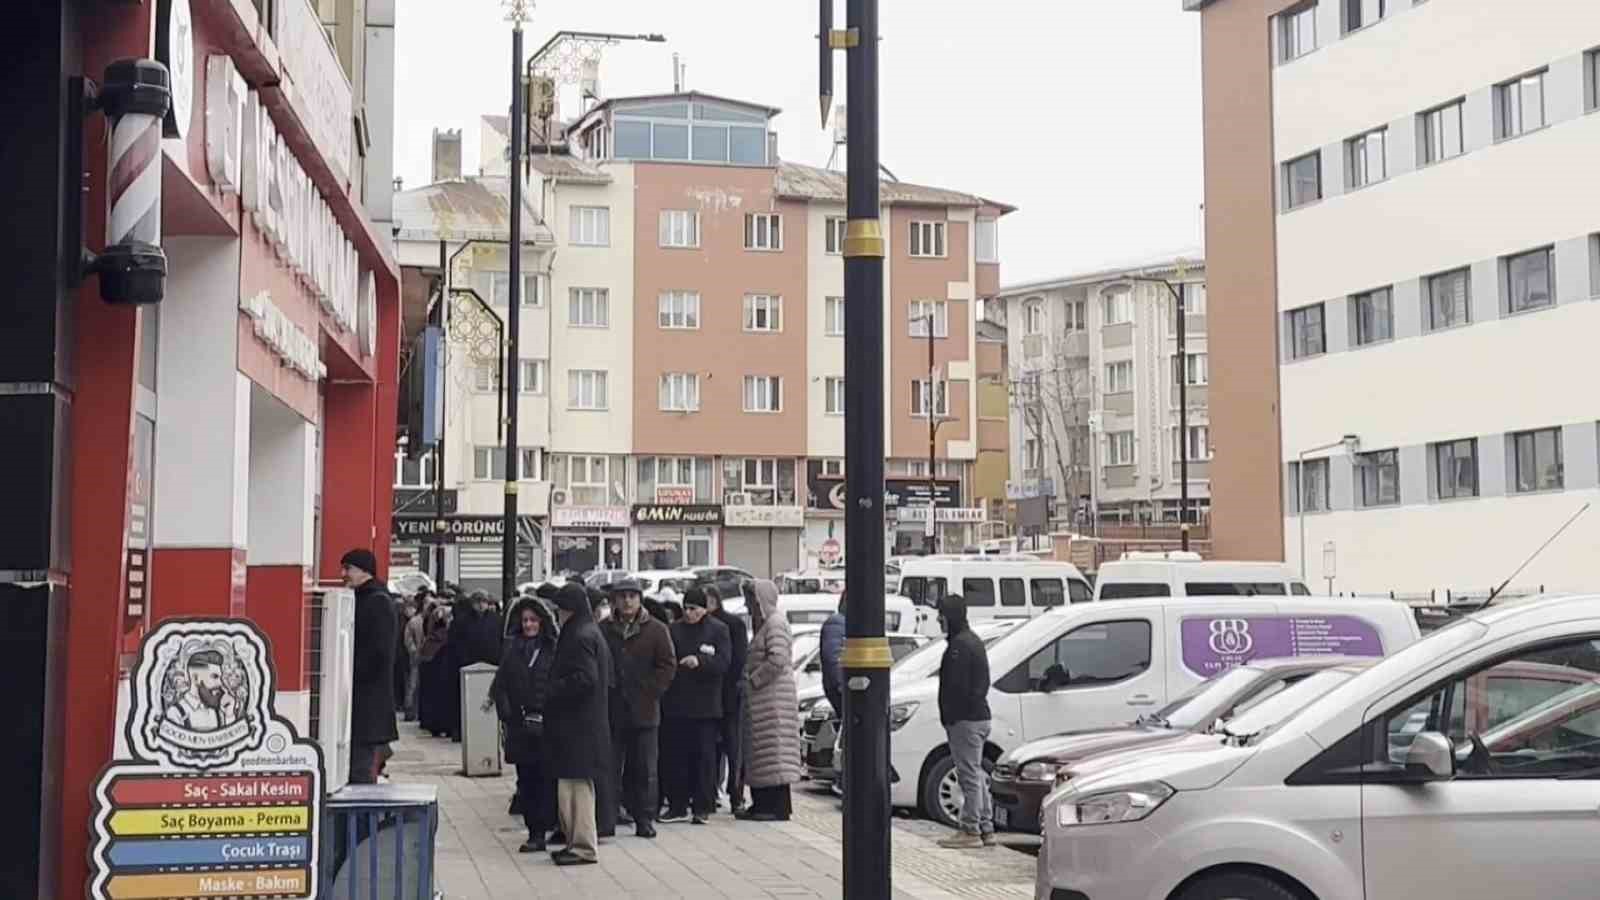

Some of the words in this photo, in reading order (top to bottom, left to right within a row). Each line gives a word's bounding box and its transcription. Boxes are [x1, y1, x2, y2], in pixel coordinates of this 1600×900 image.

[184, 783, 209, 800] Saç
[219, 782, 258, 797] Sakal
[260, 782, 302, 796] Kesim
[160, 814, 185, 831] Saç
[188, 813, 245, 830] Boyama
[256, 812, 301, 826] Perma
[221, 843, 265, 861] Çocuk
[267, 842, 301, 858] Traşı
[200, 878, 244, 892] Maske
[255, 876, 300, 890] Bakım
